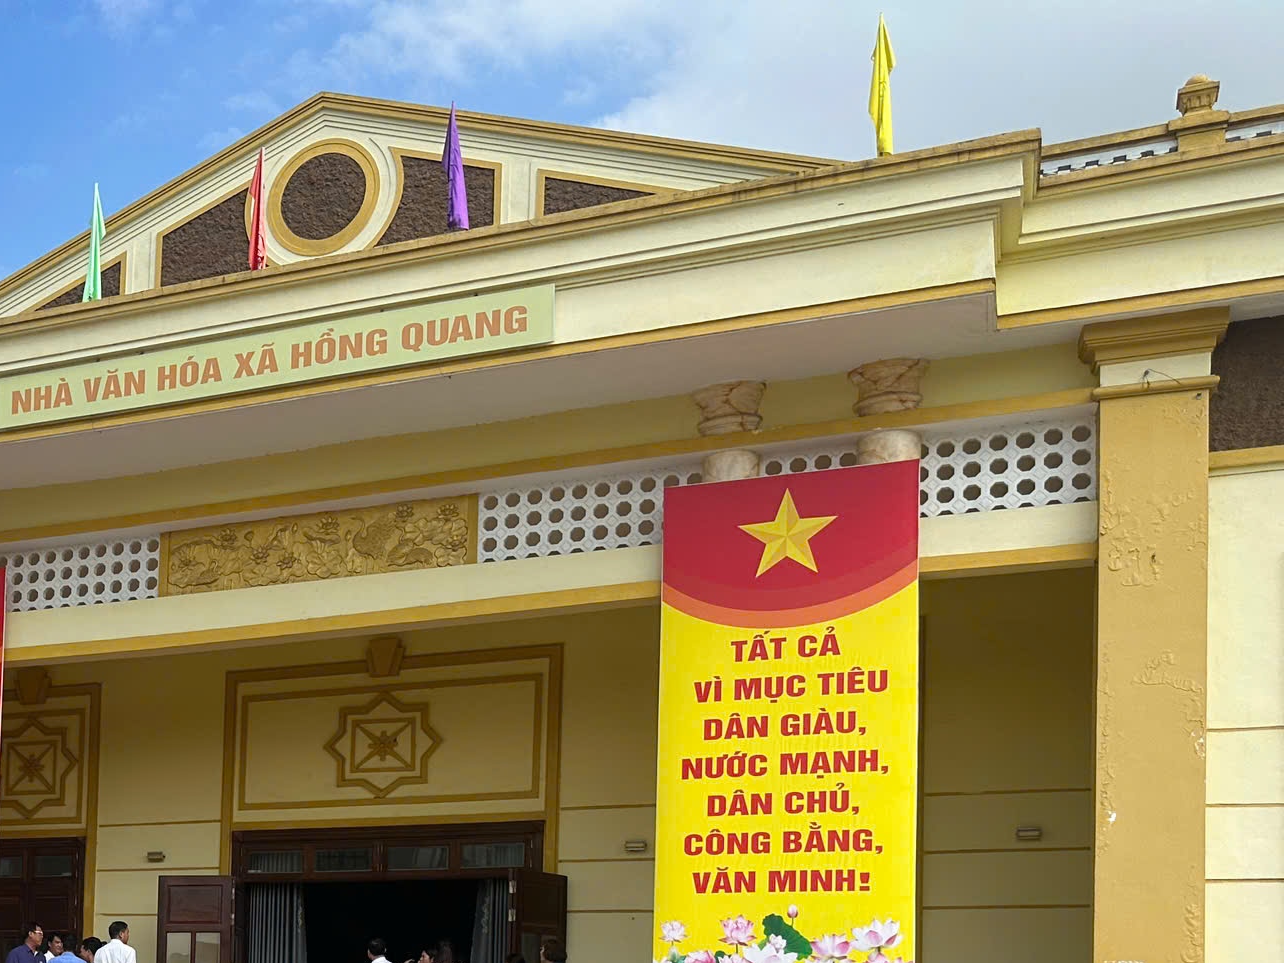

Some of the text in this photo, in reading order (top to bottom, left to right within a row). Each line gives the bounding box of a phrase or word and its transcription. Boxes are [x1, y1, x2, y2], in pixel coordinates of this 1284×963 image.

[11, 305, 526, 414] NHÀ VĂN HÓA XÃ HỒNG QUANG
[730, 626, 841, 663] TẤT CẢ
[693, 666, 888, 704] VÌ MỤC TIÊU
[703, 707, 866, 741] DÂN GIÀU,
[681, 749, 889, 781] NƯỚC MẠNH,
[707, 782, 860, 817] DÂN CHỦ,
[683, 821, 883, 857] CÔNG BẰNG,
[692, 866, 870, 894] VĂN MINH!
